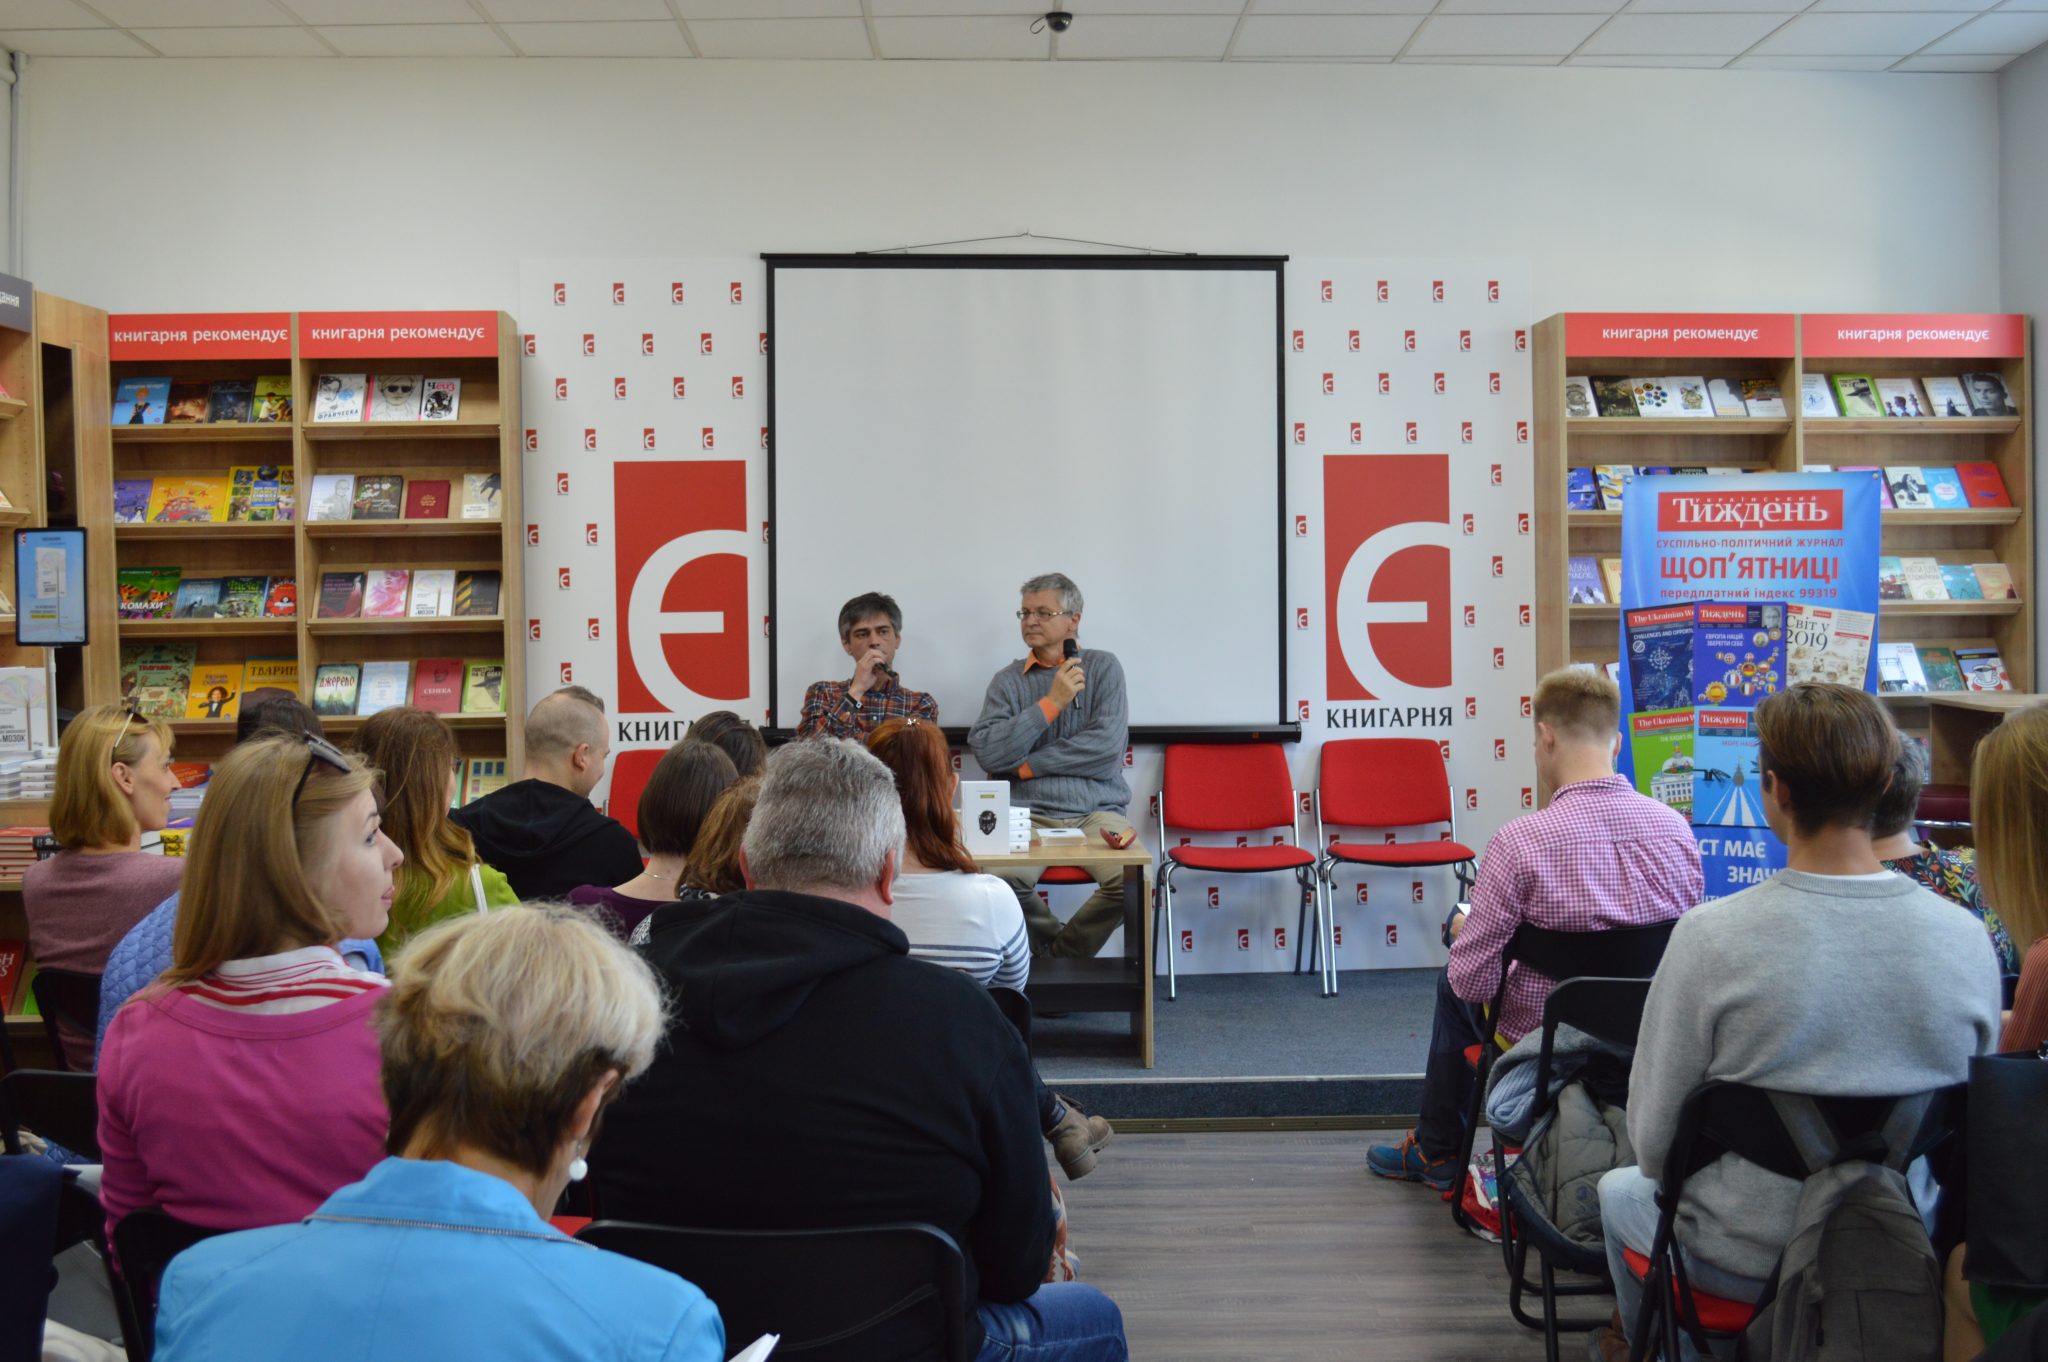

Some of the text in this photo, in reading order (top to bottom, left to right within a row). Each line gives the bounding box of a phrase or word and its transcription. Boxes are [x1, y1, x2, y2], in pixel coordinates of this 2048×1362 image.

[114, 328, 289, 346] книгарня рекомендує
[311, 326, 486, 343] книгарня рекомендує
[1602, 327, 1760, 343] книгарня рекомендує
[1837, 328, 1990, 343] книгарня рекомендує
[1672, 497, 1829, 529] Тиждень
[1656, 538, 1844, 549] СУСПІЛЬНО-ПОЛІТИЧНИЙ ЖУРНАЛ
[1660, 588, 1838, 599] передплатний індекс 99319
[120, 601, 164, 611] КОМАХИ
[1633, 614, 1648, 623] The
[1648, 610, 1684, 620] Ukrainian
[1700, 608, 1745, 620] Тиждень
[1785, 629, 1828, 652] 2019
[1326, 707, 1453, 729] КНИГАРНЯ
[1638, 718, 1653, 728] The
[1653, 715, 1690, 726] Ukrainian
[1701, 713, 1745, 726] Тиждень
[1698, 838, 1767, 858] СТ МАЄ
